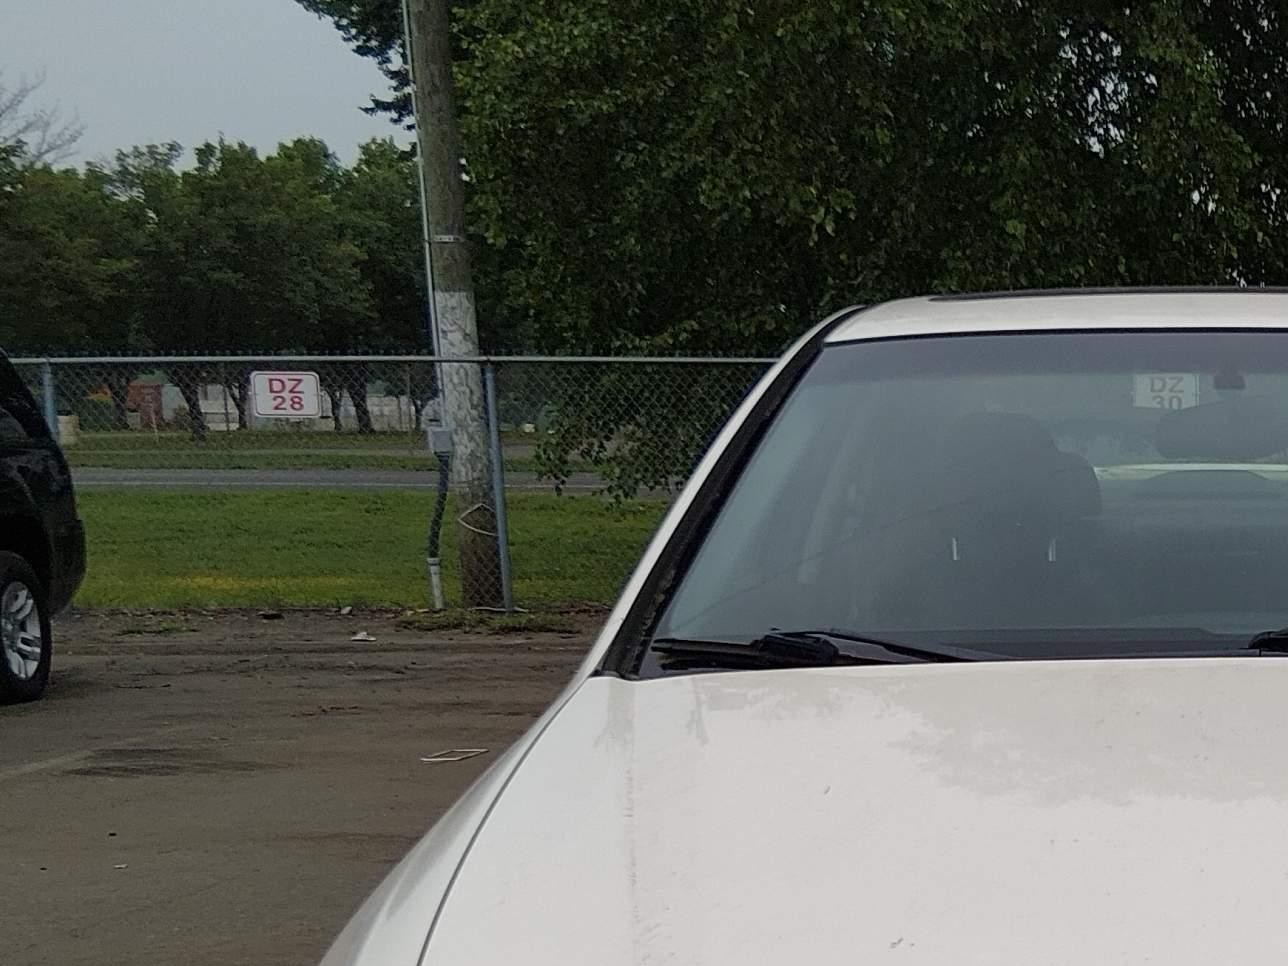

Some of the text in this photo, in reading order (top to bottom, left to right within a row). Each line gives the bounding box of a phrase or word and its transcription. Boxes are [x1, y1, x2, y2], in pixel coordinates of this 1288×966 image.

[268, 378, 305, 394] DZ
[1150, 376, 1185, 393] DZ
[272, 395, 305, 411] 28
